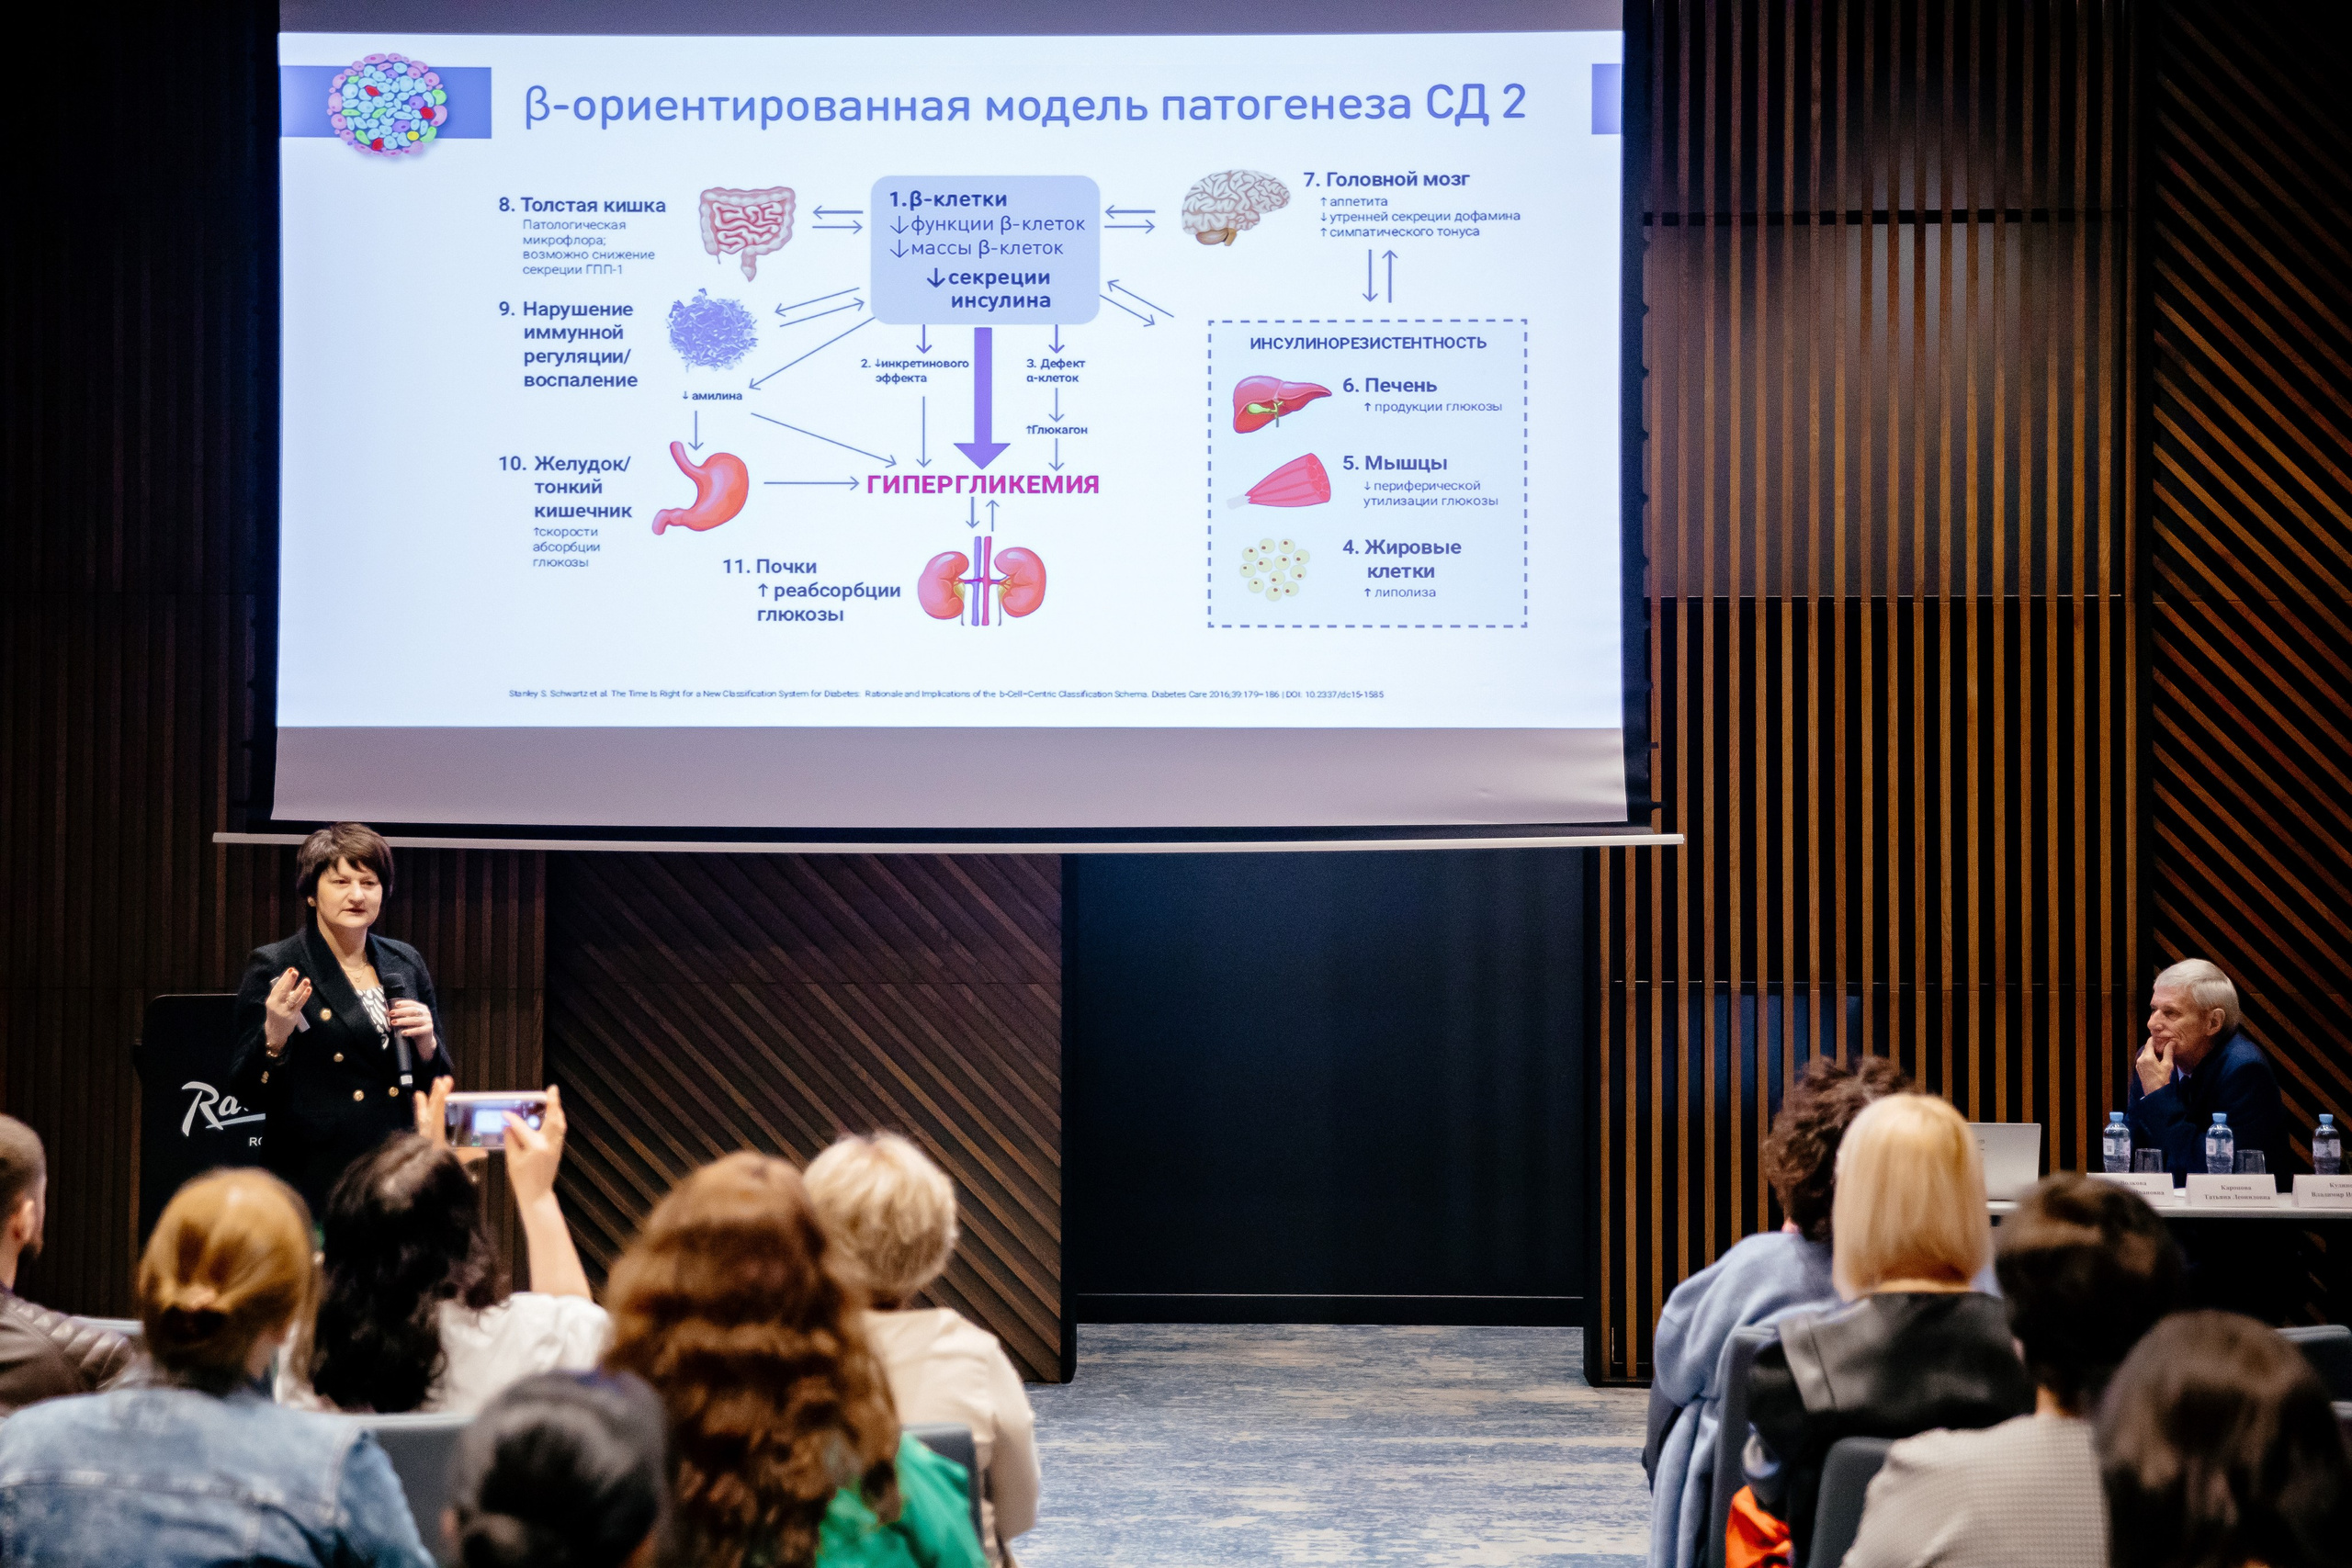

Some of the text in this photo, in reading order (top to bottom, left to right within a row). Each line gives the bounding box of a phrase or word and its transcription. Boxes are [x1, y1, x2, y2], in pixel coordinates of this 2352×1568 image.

[526, 83, 1526, 131] β-ориентированная модель патогенеза СД 2
[1303, 170, 1471, 187] 7. Головной мозг
[498, 196, 666, 213] 8. Толстая кишка
[1329, 197, 1388, 208] аппетита
[1329, 209, 1521, 225] утренней секреции дофамина
[523, 219, 627, 231] Патологическая
[910, 214, 1086, 236] функции β-клеток
[1329, 227, 1480, 239] симпатического тонуса
[522, 234, 606, 248] микрофлора;
[523, 250, 656, 261] возможно снижение
[911, 239, 1064, 260] массы β-клеток
[522, 264, 623, 277] секреции ГПП-1
[948, 272, 1050, 289] секреции
[498, 300, 634, 321] 9. Нарушение
[951, 295, 1051, 313] инсулина
[524, 323, 624, 344] иммунной
[1250, 336, 1487, 350] ИНСУЛИНОРЕЗИСТЕНТНОСТЬ
[524, 348, 632, 367] регуляции/
[860, 358, 969, 369] 2. инкретинового
[1026, 357, 1086, 371] 3. Дефект
[524, 375, 639, 388] воспаление
[875, 372, 928, 385] эффекта
[1342, 377, 1438, 393] 6. Печень
[691, 392, 743, 400] амилина
[1374, 402, 1503, 415] продукции глюкозы
[1029, 424, 1088, 434] Глюкагон
[499, 455, 631, 475] 10. Желудок/
[1342, 455, 1448, 474] 5. Мышцы
[534, 478, 603, 494] тонкий
[867, 475, 1100, 494] ГИПЕРГЛИКЕМИЯ
[1374, 479, 1481, 493] периферической
[1363, 497, 1498, 509] утилизации глюкозы
[534, 506, 633, 518] кишечник
[536, 526, 598, 539] скорости
[532, 541, 601, 555] абсорбции
[1342, 538, 1463, 558] 4. Жировые
[532, 558, 589, 568] глюкозы
[722, 558, 817, 574] 11. Почки
[1367, 566, 1435, 579] клетки
[774, 581, 901, 602] реабсорбции
[1374, 589, 1437, 598] липолиза
[757, 609, 844, 622] глюкозы
[611, 690, 627, 698] The
[628, 690, 649, 698] Time
[650, 690, 657, 698] Is
[660, 690, 680, 700] Right
[682, 690, 694, 698] for
[703, 690, 721, 698] New
[722, 690, 776, 698] Classification
[778, 690, 809, 700] System
[810, 690, 822, 698] for
[865, 690, 903, 698] Rationale
[904, 690, 920, 698] and
[922, 690, 970, 700] Implications
[972, 690, 981, 698] of
[982, 690, 996, 698] the
[1058, 690, 1113, 698] Classification
[1151, 690, 1186, 698] Diabetes
[1188, 690, 1207, 698] Care
[182, 1081, 249, 1136] Ra
